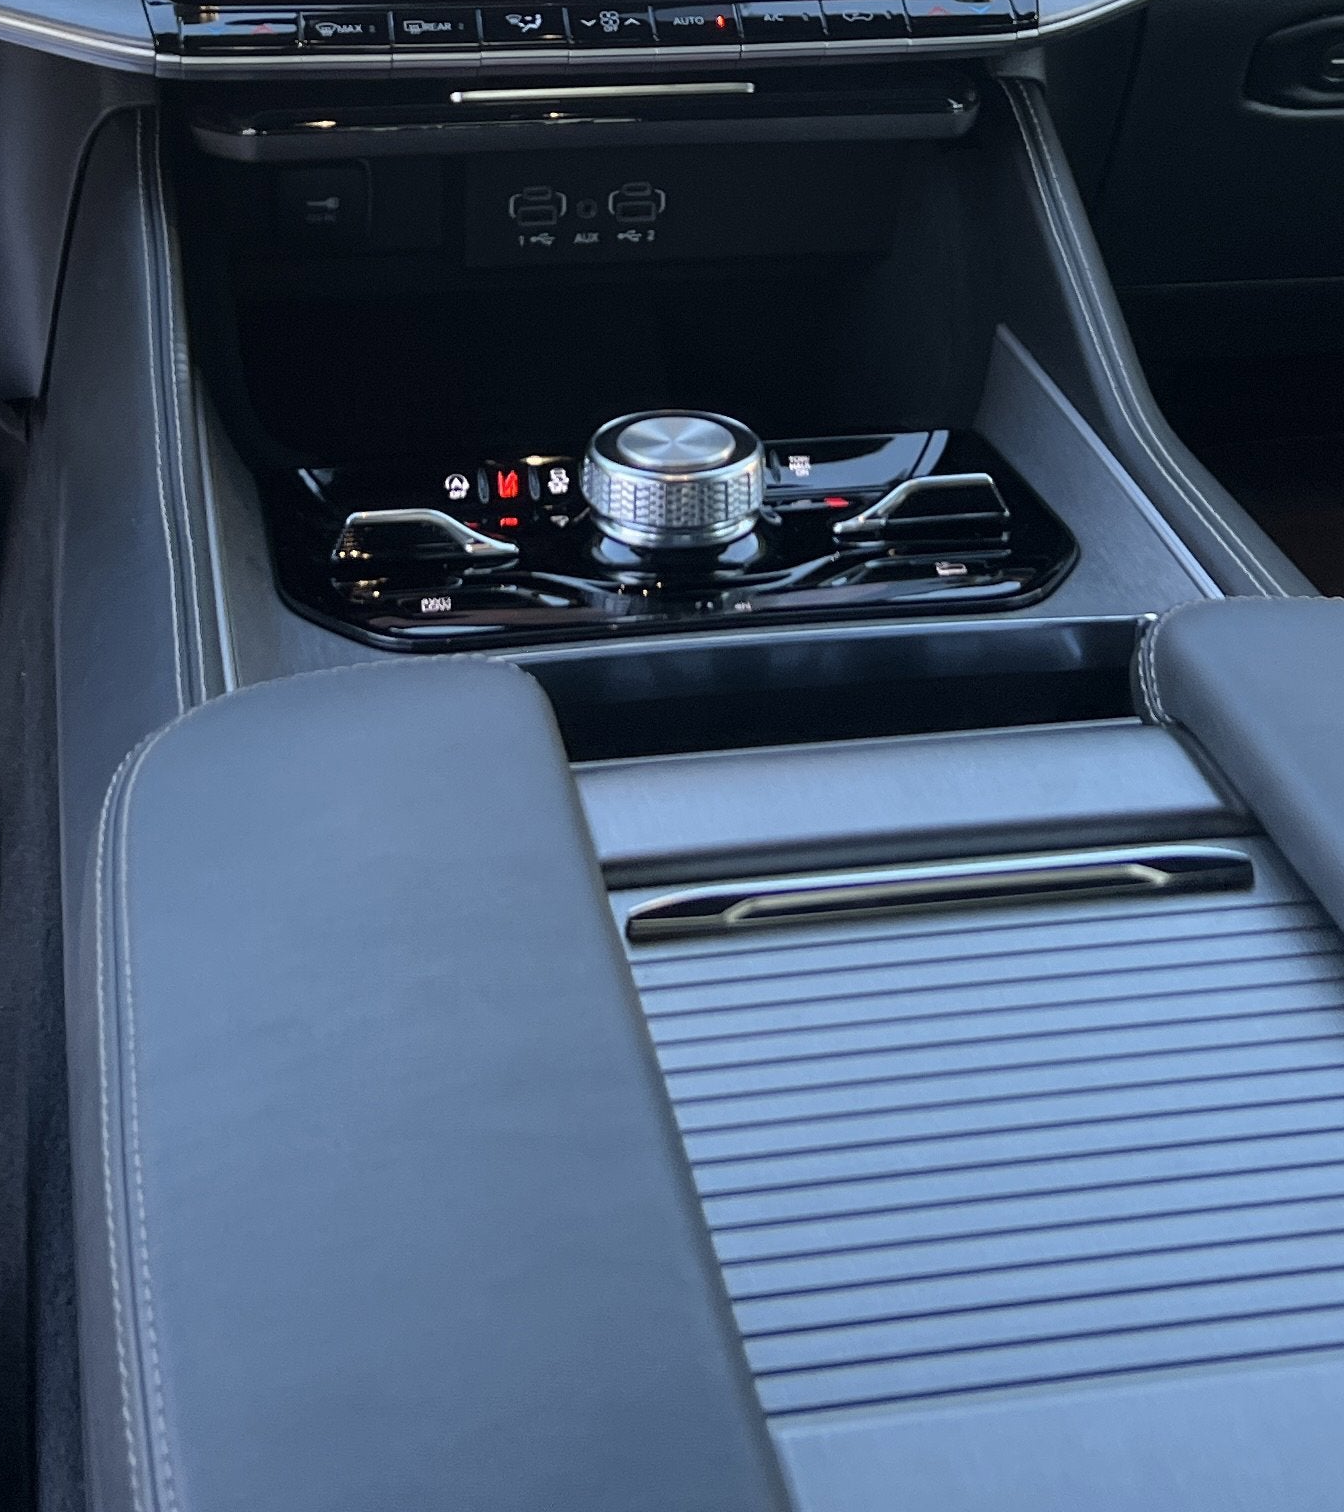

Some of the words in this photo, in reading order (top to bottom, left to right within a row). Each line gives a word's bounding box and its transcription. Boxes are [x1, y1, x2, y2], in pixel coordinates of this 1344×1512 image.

[673, 15, 705, 26] AUTO
[763, 11, 784, 23] A/C
[336, 23, 363, 34] MAX
[574, 232, 600, 244] AUX
